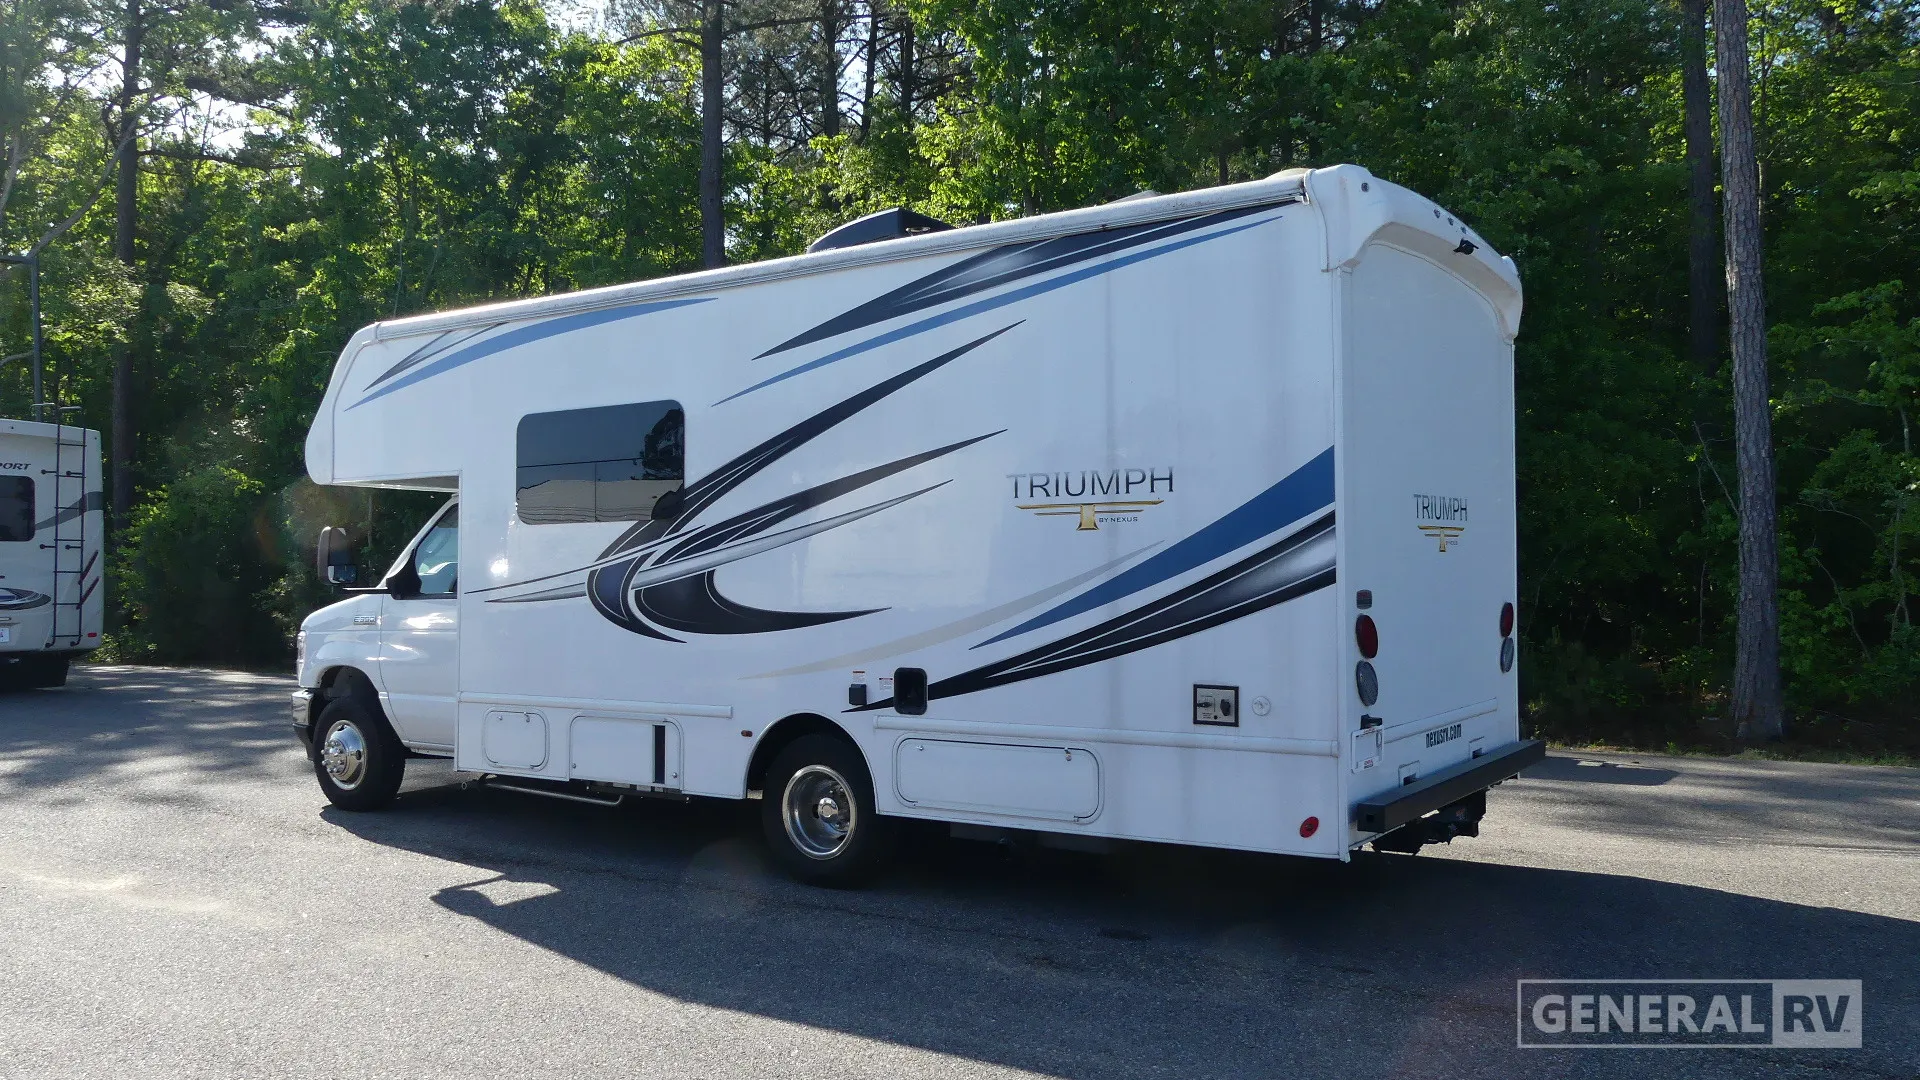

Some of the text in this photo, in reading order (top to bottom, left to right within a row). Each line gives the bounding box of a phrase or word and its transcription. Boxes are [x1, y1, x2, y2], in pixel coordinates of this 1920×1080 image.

[1006, 466, 1174, 499] TRIUMPH
[1413, 493, 1468, 521] TRIUMPH
[1425, 723, 1462, 748] nexusrv.com
